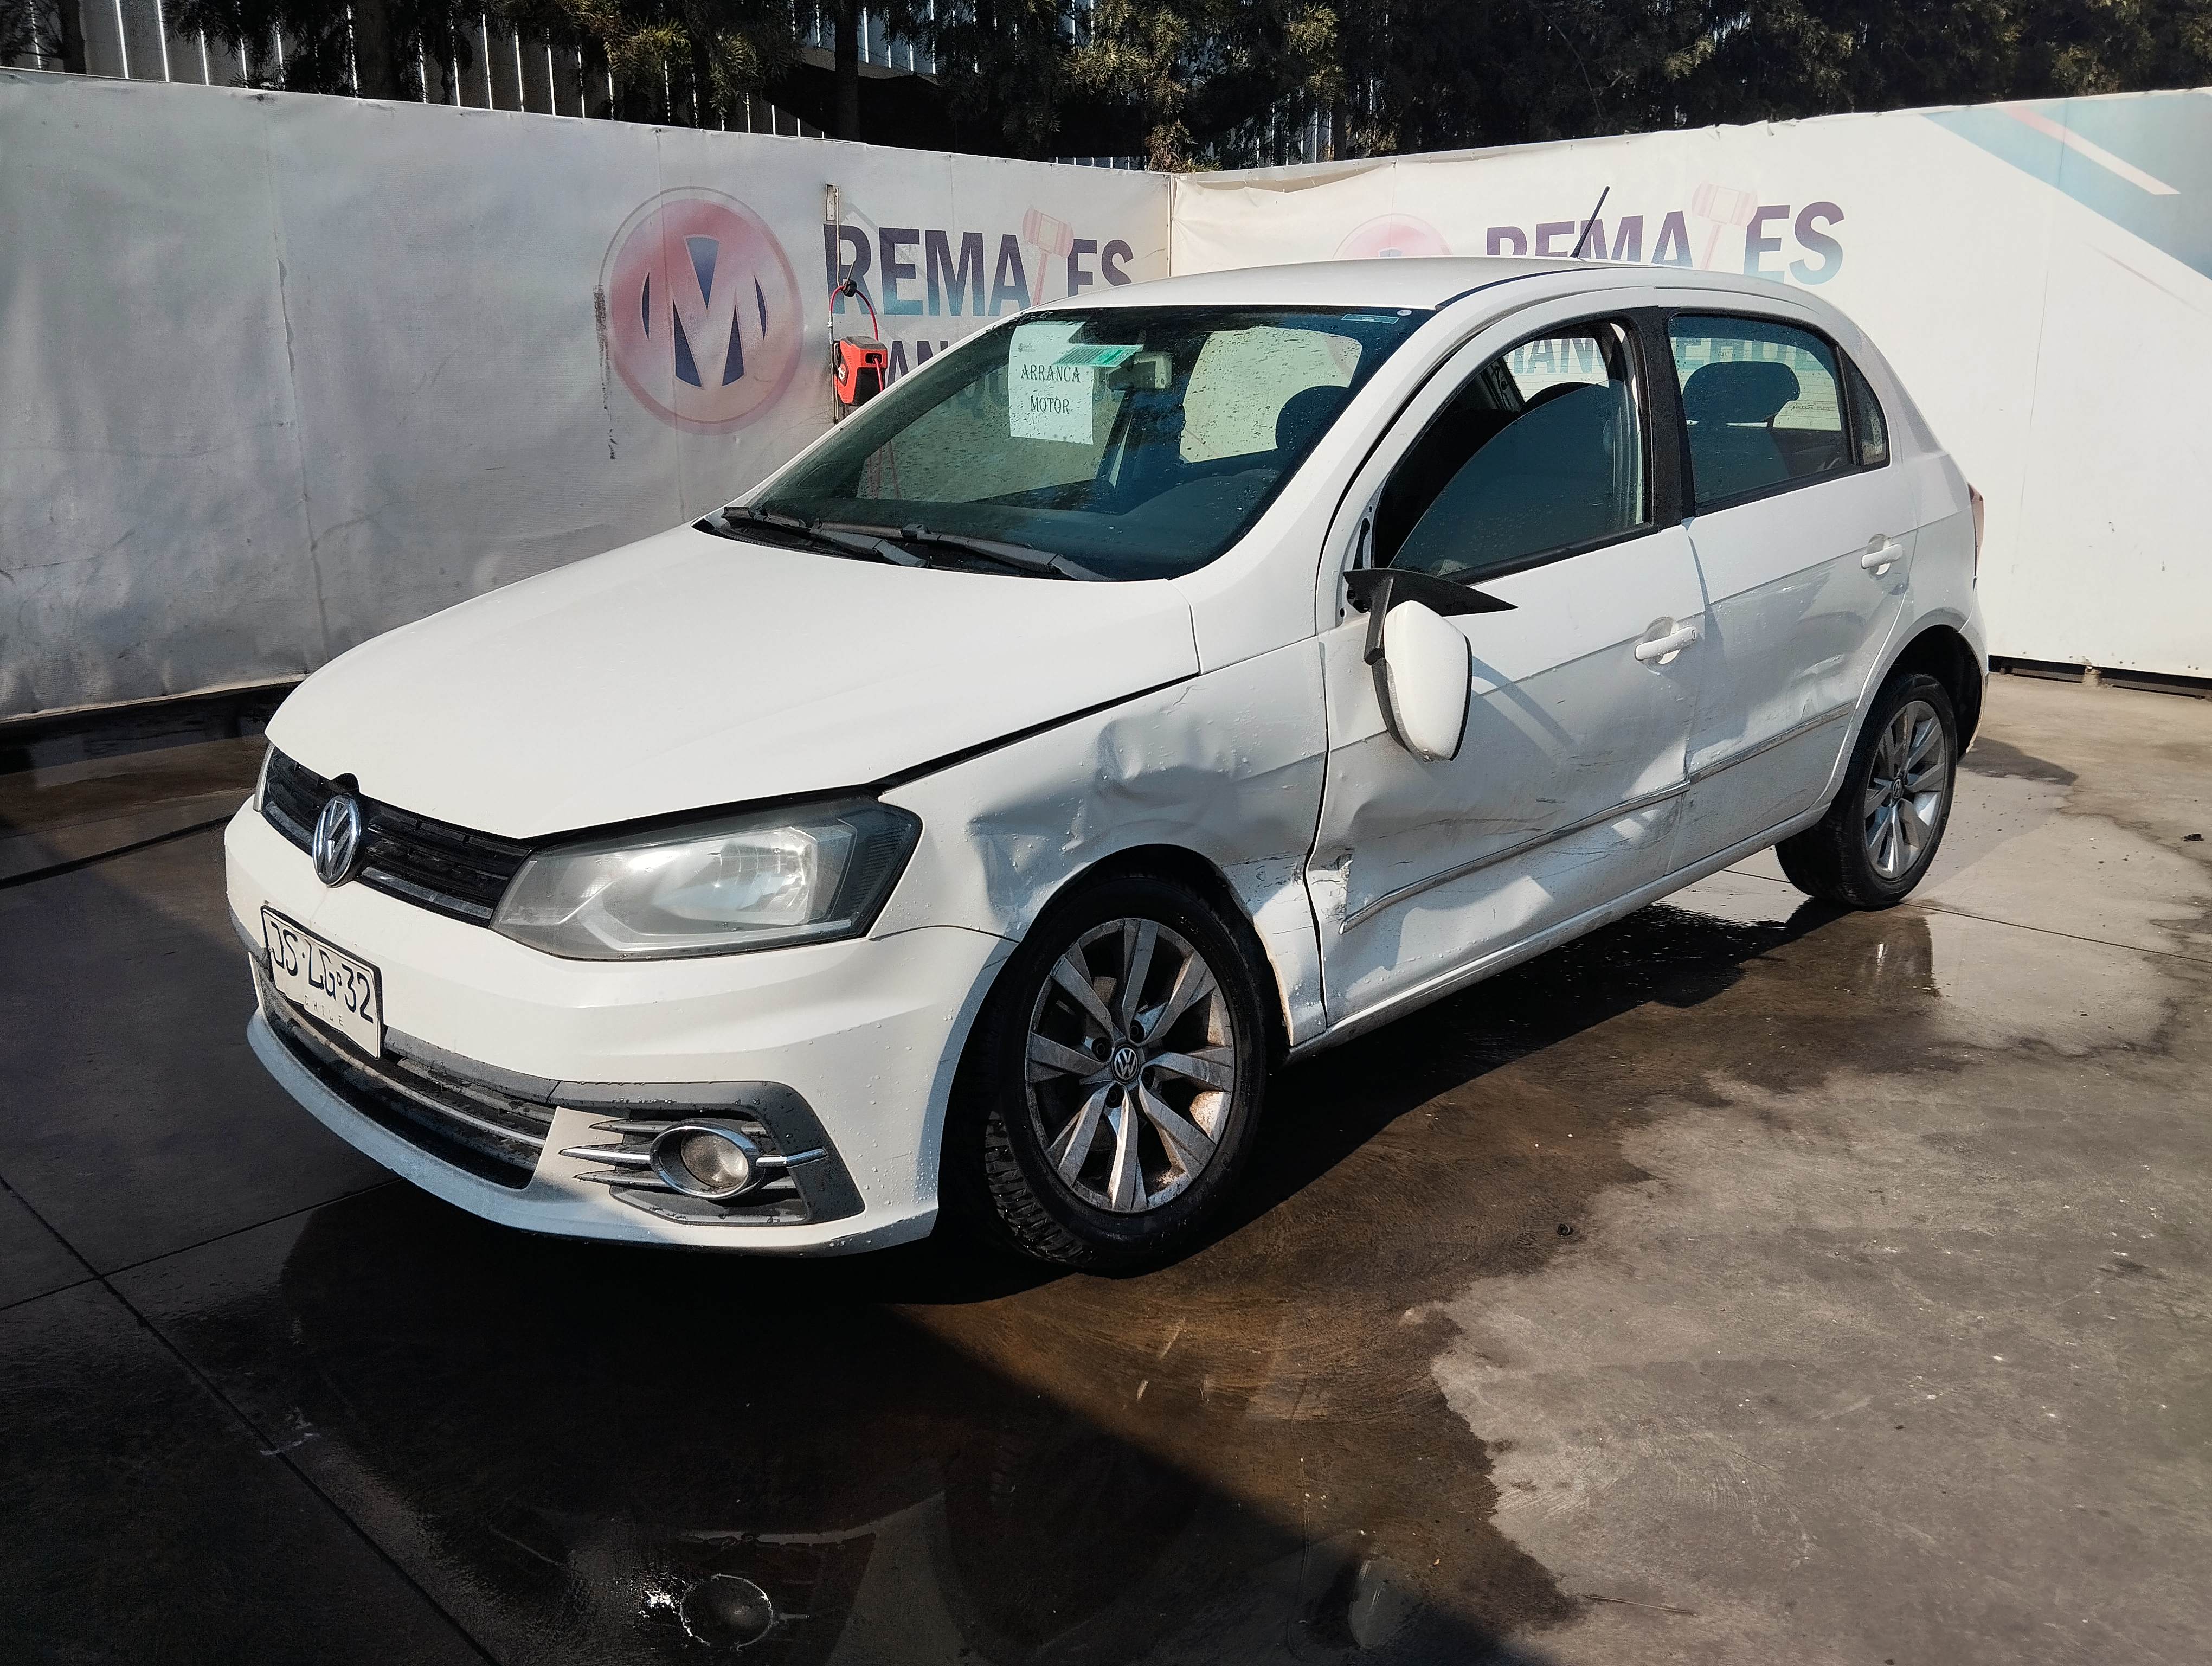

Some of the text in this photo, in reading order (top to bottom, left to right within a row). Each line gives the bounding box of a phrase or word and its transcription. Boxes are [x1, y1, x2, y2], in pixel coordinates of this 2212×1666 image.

[1020, 364, 1081, 383] ARRANCA
[1030, 395, 1070, 414] MOTOR
[304, 995, 345, 1026] CHILE
